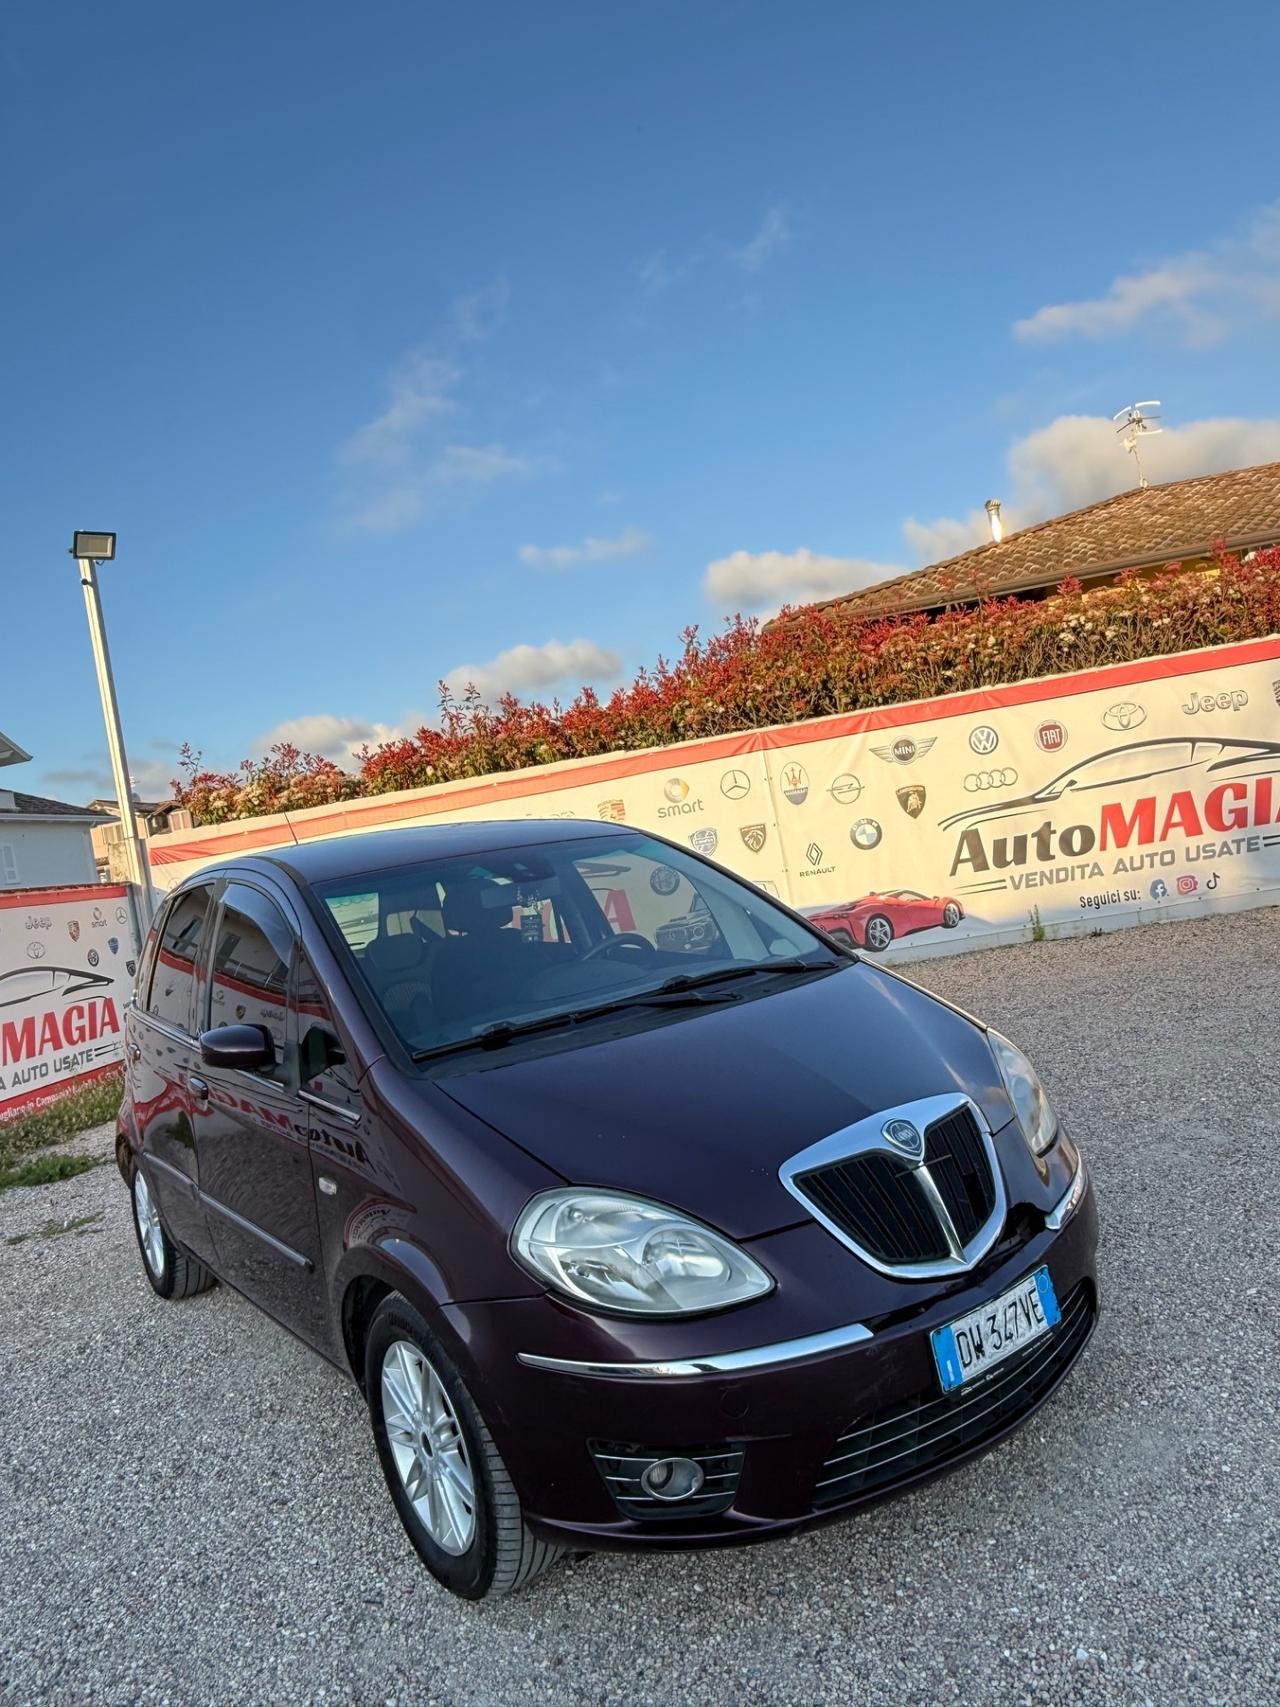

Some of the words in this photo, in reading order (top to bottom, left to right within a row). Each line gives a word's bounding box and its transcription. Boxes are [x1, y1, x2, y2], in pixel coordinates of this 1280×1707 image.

[1181, 689, 1249, 715] Jeep
[1041, 728, 1061, 745] FIAT
[894, 745, 915, 755] MINI
[657, 798, 704, 818] smart
[949, 776, 1280, 877] AutoMAGI
[800, 866, 836, 877] RENAULT
[1009, 860, 1105, 891] VENDITA
[1112, 849, 1176, 875] AUTO
[1185, 835, 1261, 863] USATE
[1079, 892, 1121, 910] Seguici
[1123, 889, 1142, 902] su:
[12, 1062, 49, 1088] AUTO
[53, 1048, 94, 1073] USATE
